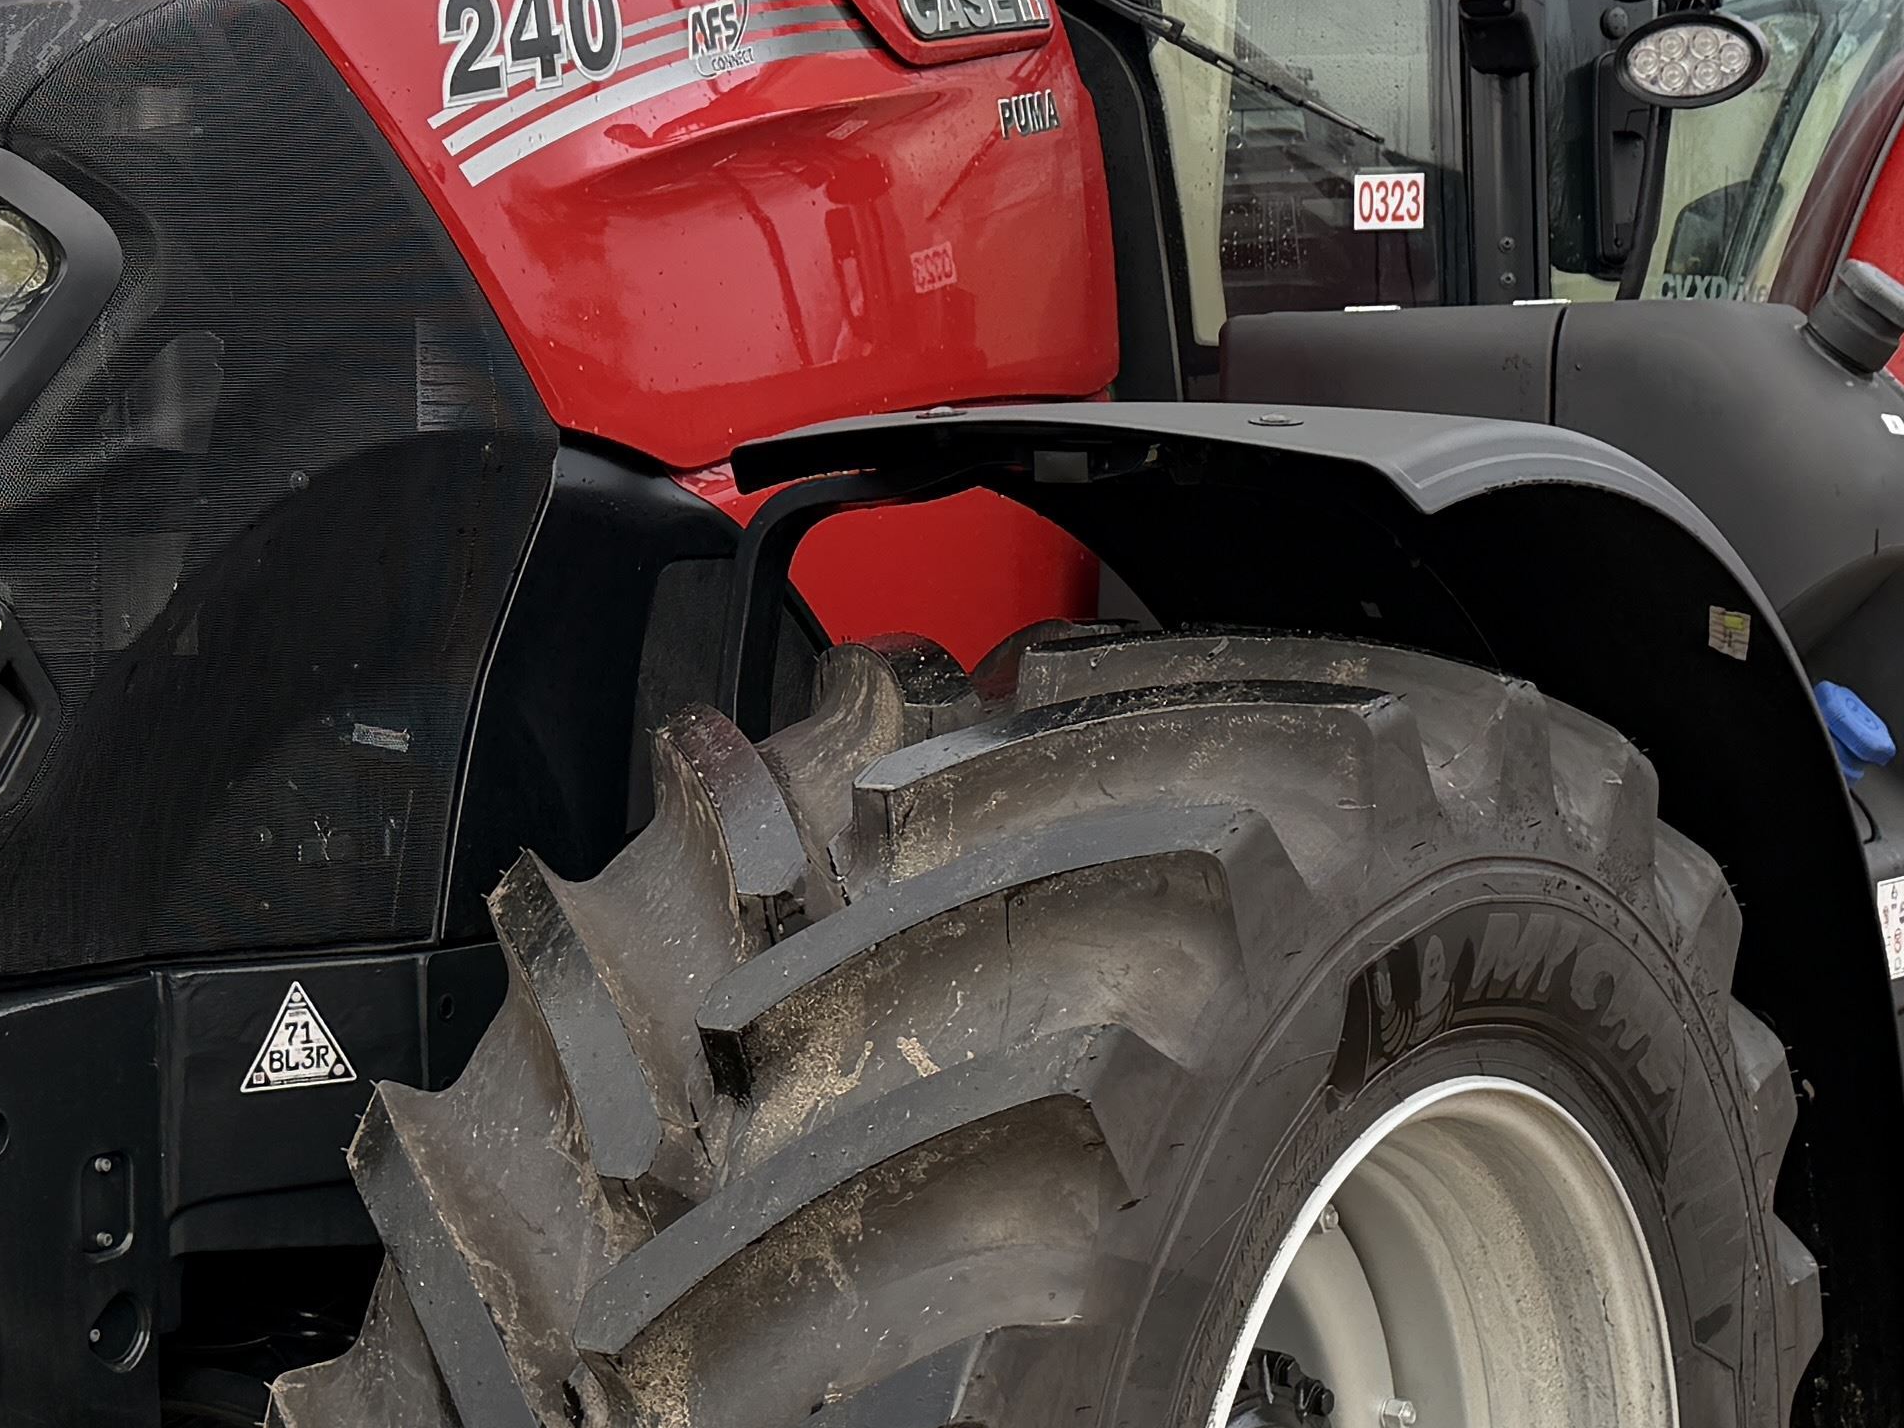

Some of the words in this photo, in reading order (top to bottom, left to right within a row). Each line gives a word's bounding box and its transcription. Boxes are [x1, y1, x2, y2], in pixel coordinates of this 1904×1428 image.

[690, 3, 739, 57] AFS
[710, 47, 755, 72] CONNECT
[997, 88, 1062, 141] PUMA
[1358, 180, 1421, 223] 0323
[284, 1020, 314, 1046] 71
[268, 1044, 330, 1073] BL3R
